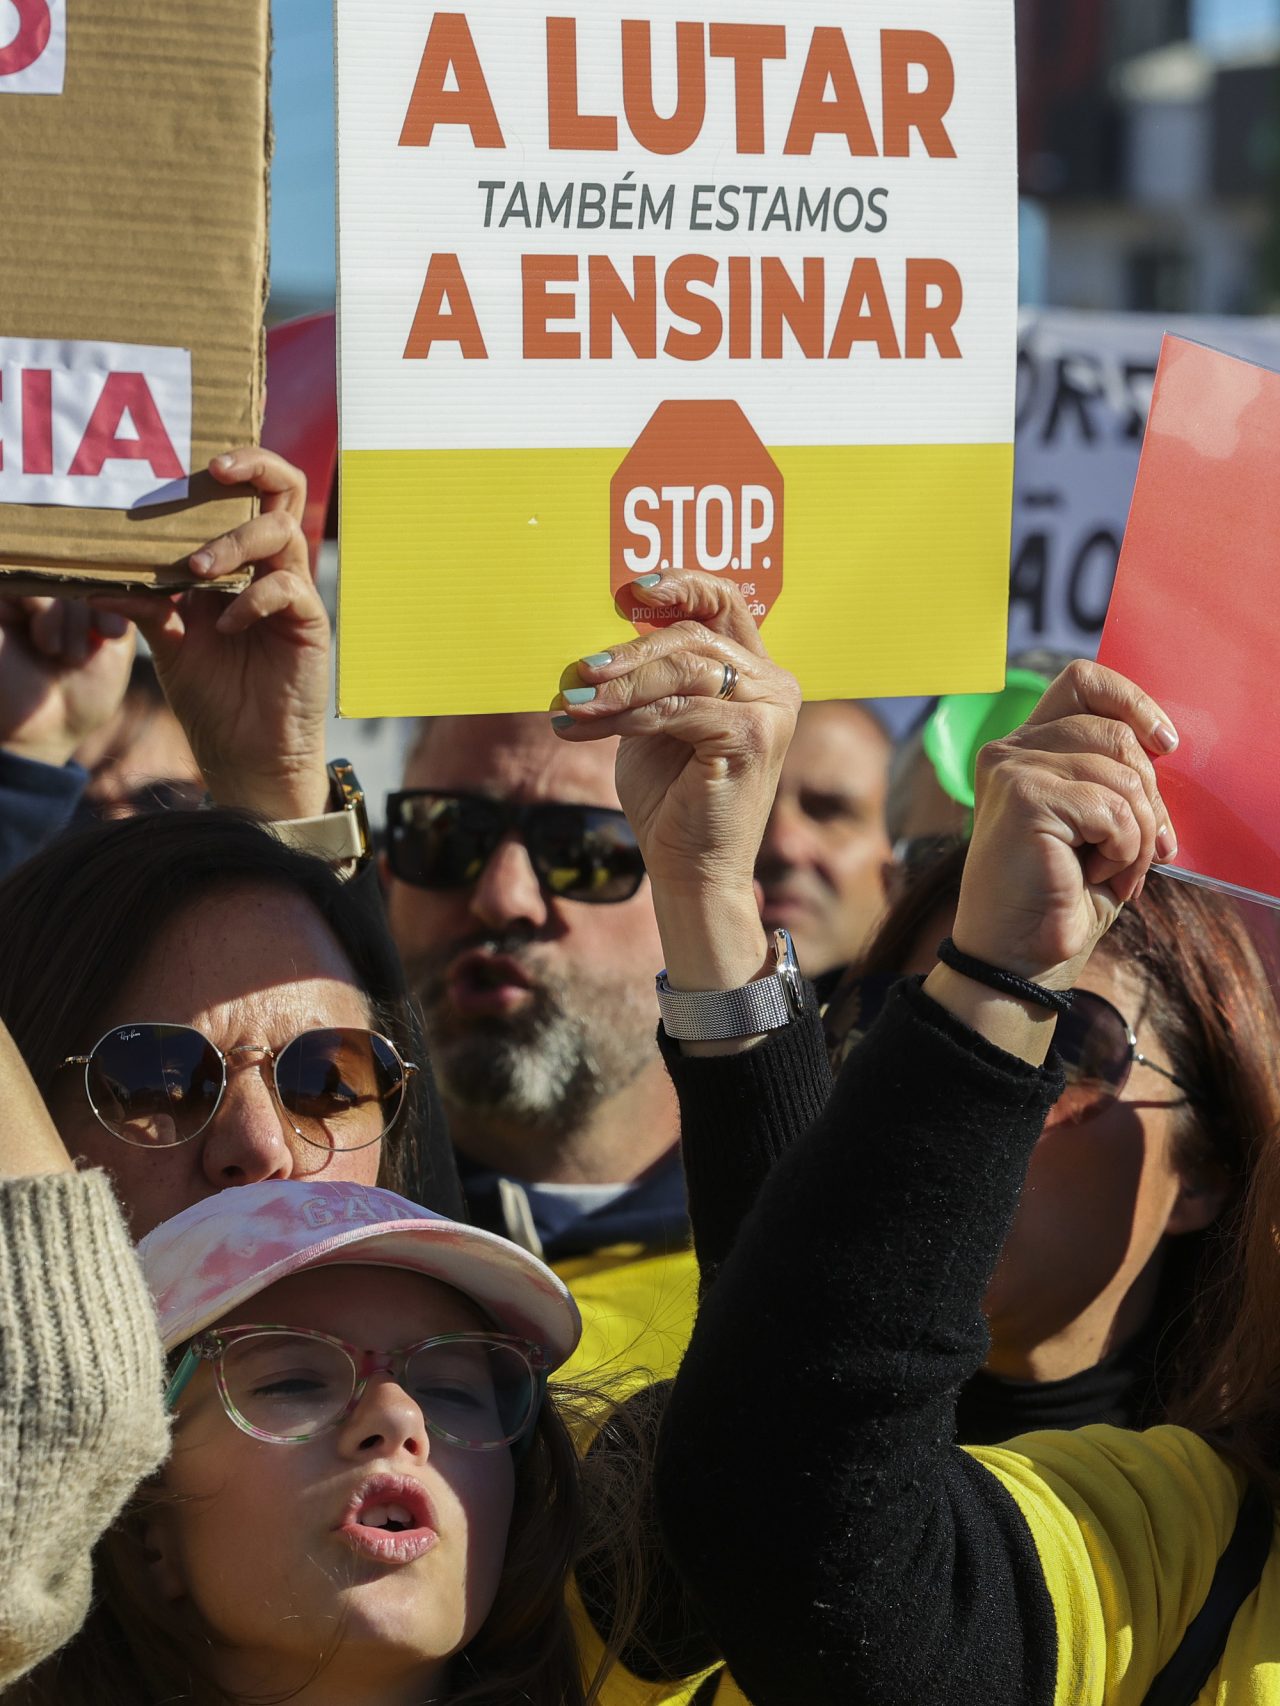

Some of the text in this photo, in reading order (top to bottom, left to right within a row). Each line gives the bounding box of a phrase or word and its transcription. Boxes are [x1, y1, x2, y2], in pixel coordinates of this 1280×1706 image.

[397, 11, 958, 159] A LUTAR
[477, 171, 889, 234] TAMBÉM ESTAMOS
[402, 252, 963, 362] A ENSINAR
[0, 368, 188, 479] IA
